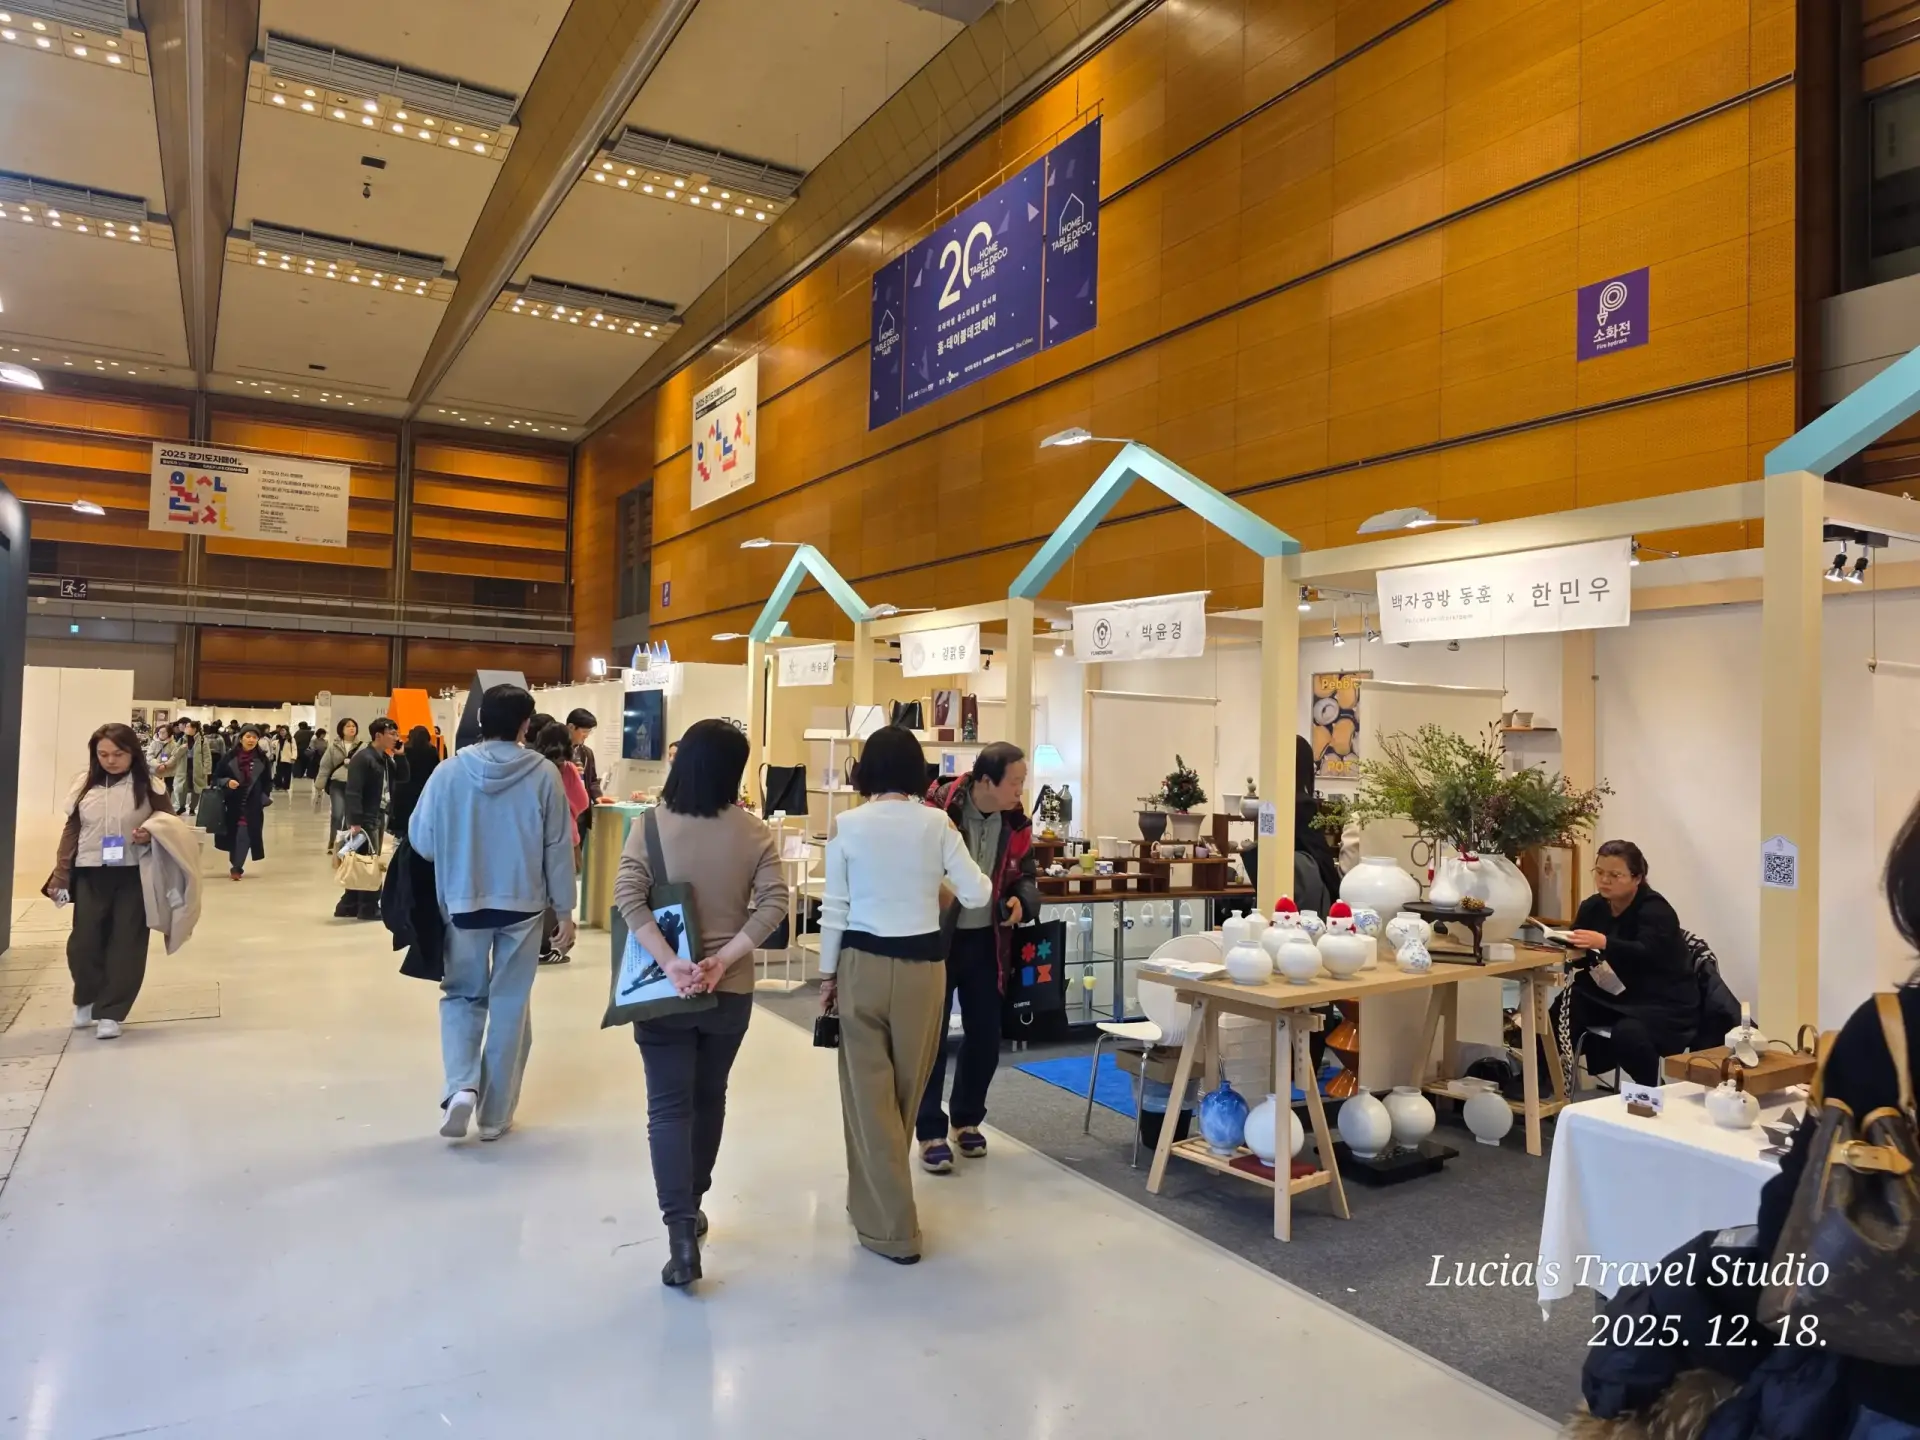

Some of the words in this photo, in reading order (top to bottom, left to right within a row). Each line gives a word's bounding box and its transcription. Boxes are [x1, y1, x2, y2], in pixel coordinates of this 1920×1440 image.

[1061, 215, 1082, 235] HOME
[1051, 233, 1072, 252] TABLE
[1071, 221, 1093, 240] DECO
[979, 240, 999, 261] HOME
[1063, 239, 1079, 255] FAIR
[969, 258, 989, 277] TABLE
[988, 246, 1008, 266] DECO
[980, 265, 996, 281] FAIR
[1593, 320, 1631, 343] 소화전
[1607, 337, 1628, 347] hydrant
[160, 449, 186, 458] 2025
[79, 583, 87, 593] 2
[1391, 588, 1452, 612] 백자공방
[1459, 584, 1492, 606] 동훈
[1531, 577, 1611, 608] 한민우
[1141, 621, 1182, 641] 박윤경
[1327, 760, 1352, 774] POT
